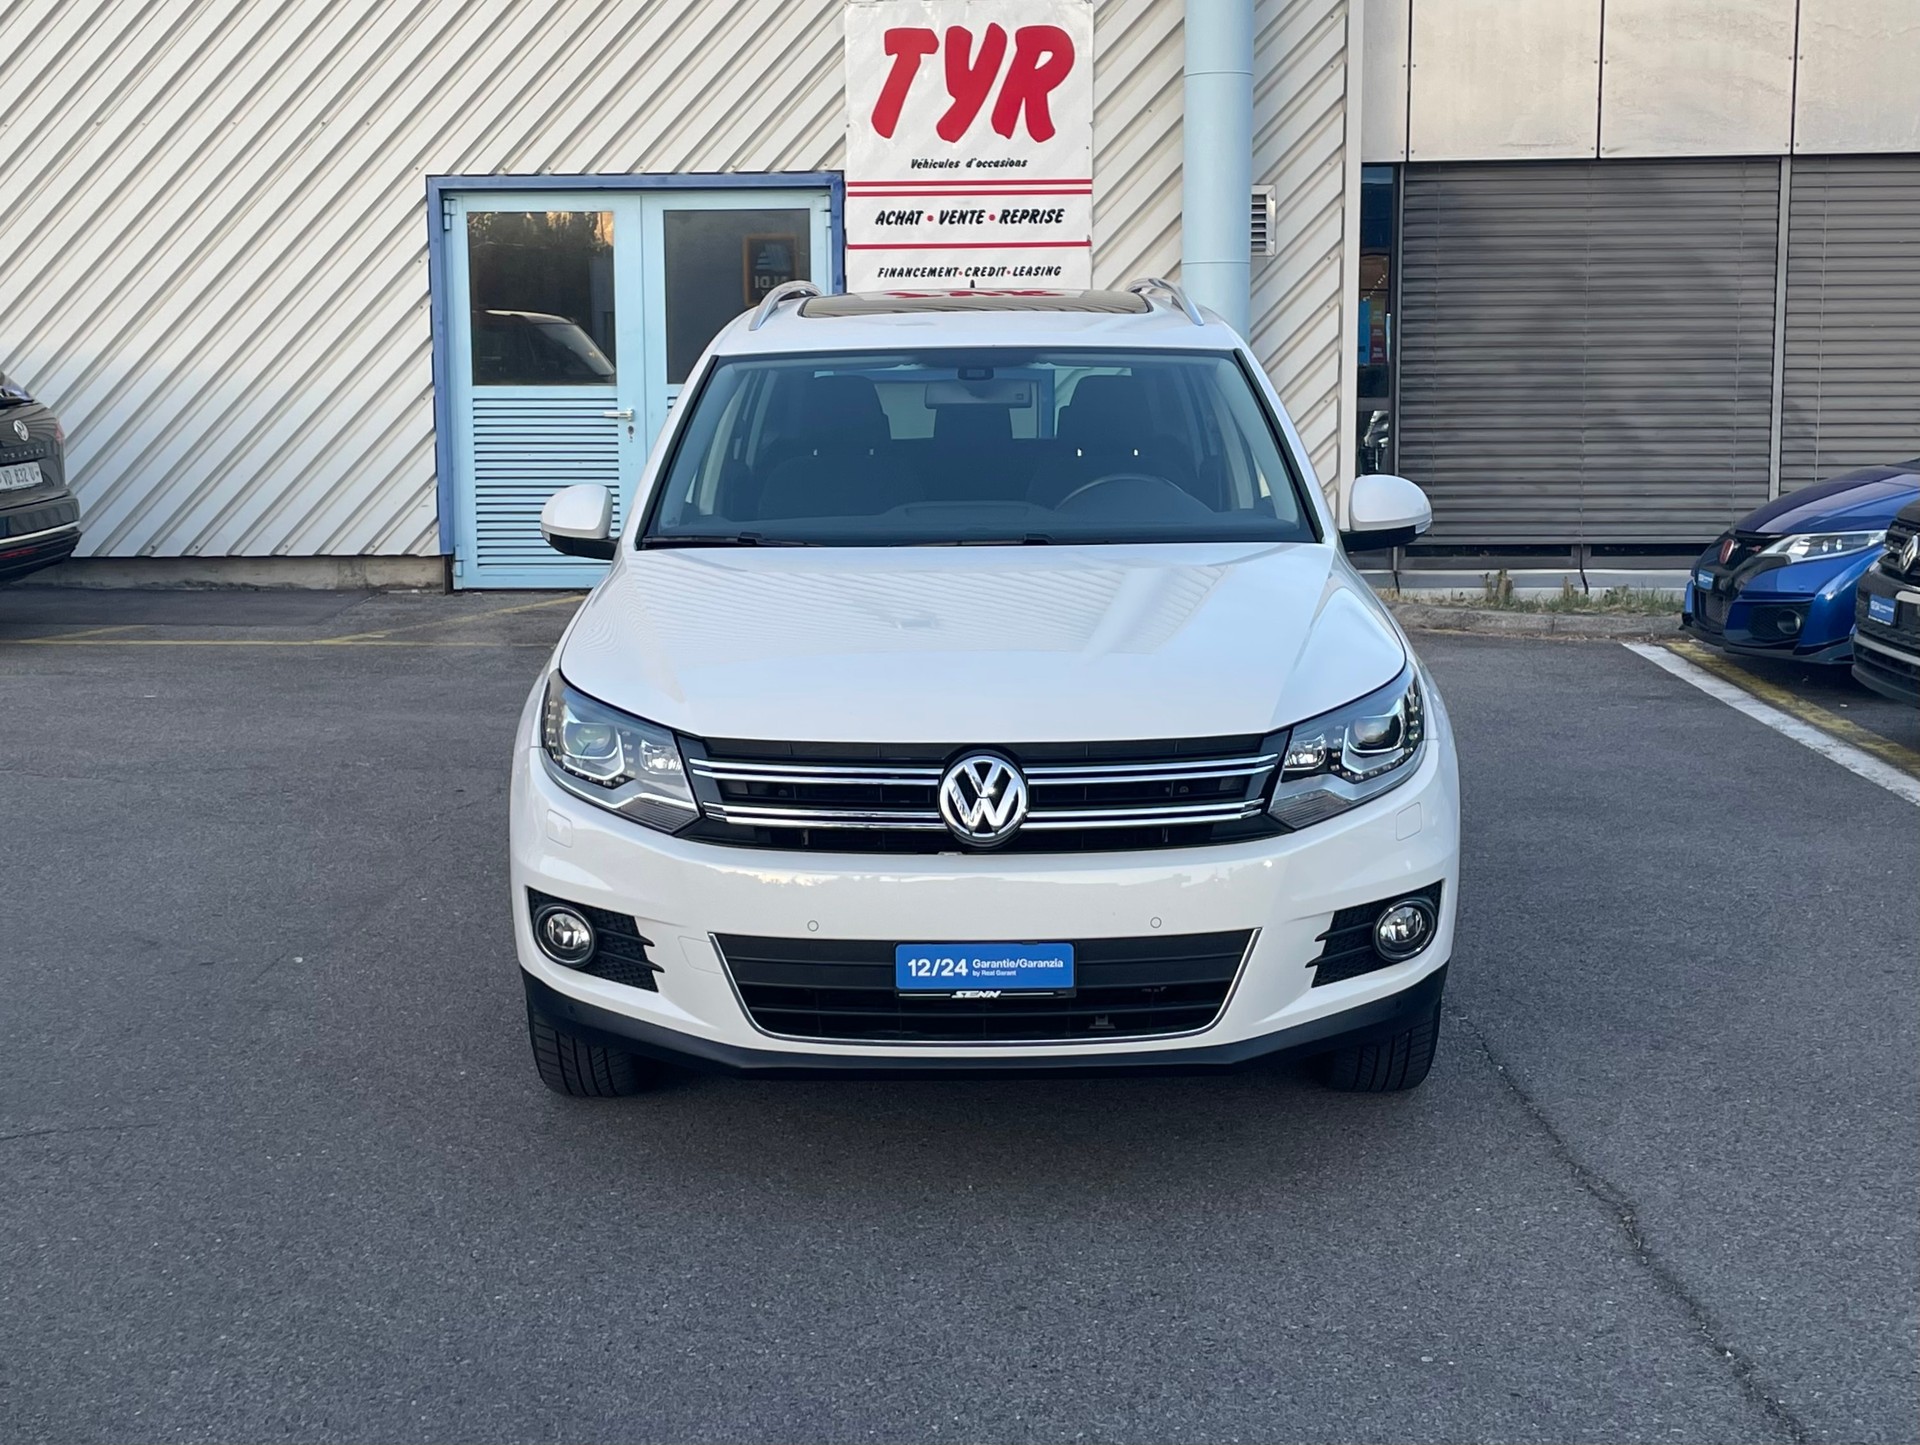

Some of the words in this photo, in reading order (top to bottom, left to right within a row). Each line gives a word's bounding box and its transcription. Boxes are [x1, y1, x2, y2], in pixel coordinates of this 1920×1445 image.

[871, 22, 1075, 143] TYR
[910, 157, 960, 169] Véhicules
[965, 157, 1028, 168] d'occasions
[875, 209, 924, 226] ACHAT
[938, 209, 986, 225] VENTE
[999, 208, 1065, 224] REPRISE
[907, 958, 968, 977] 12/24
[972, 957, 1064, 969] Garantie/Garanzia
